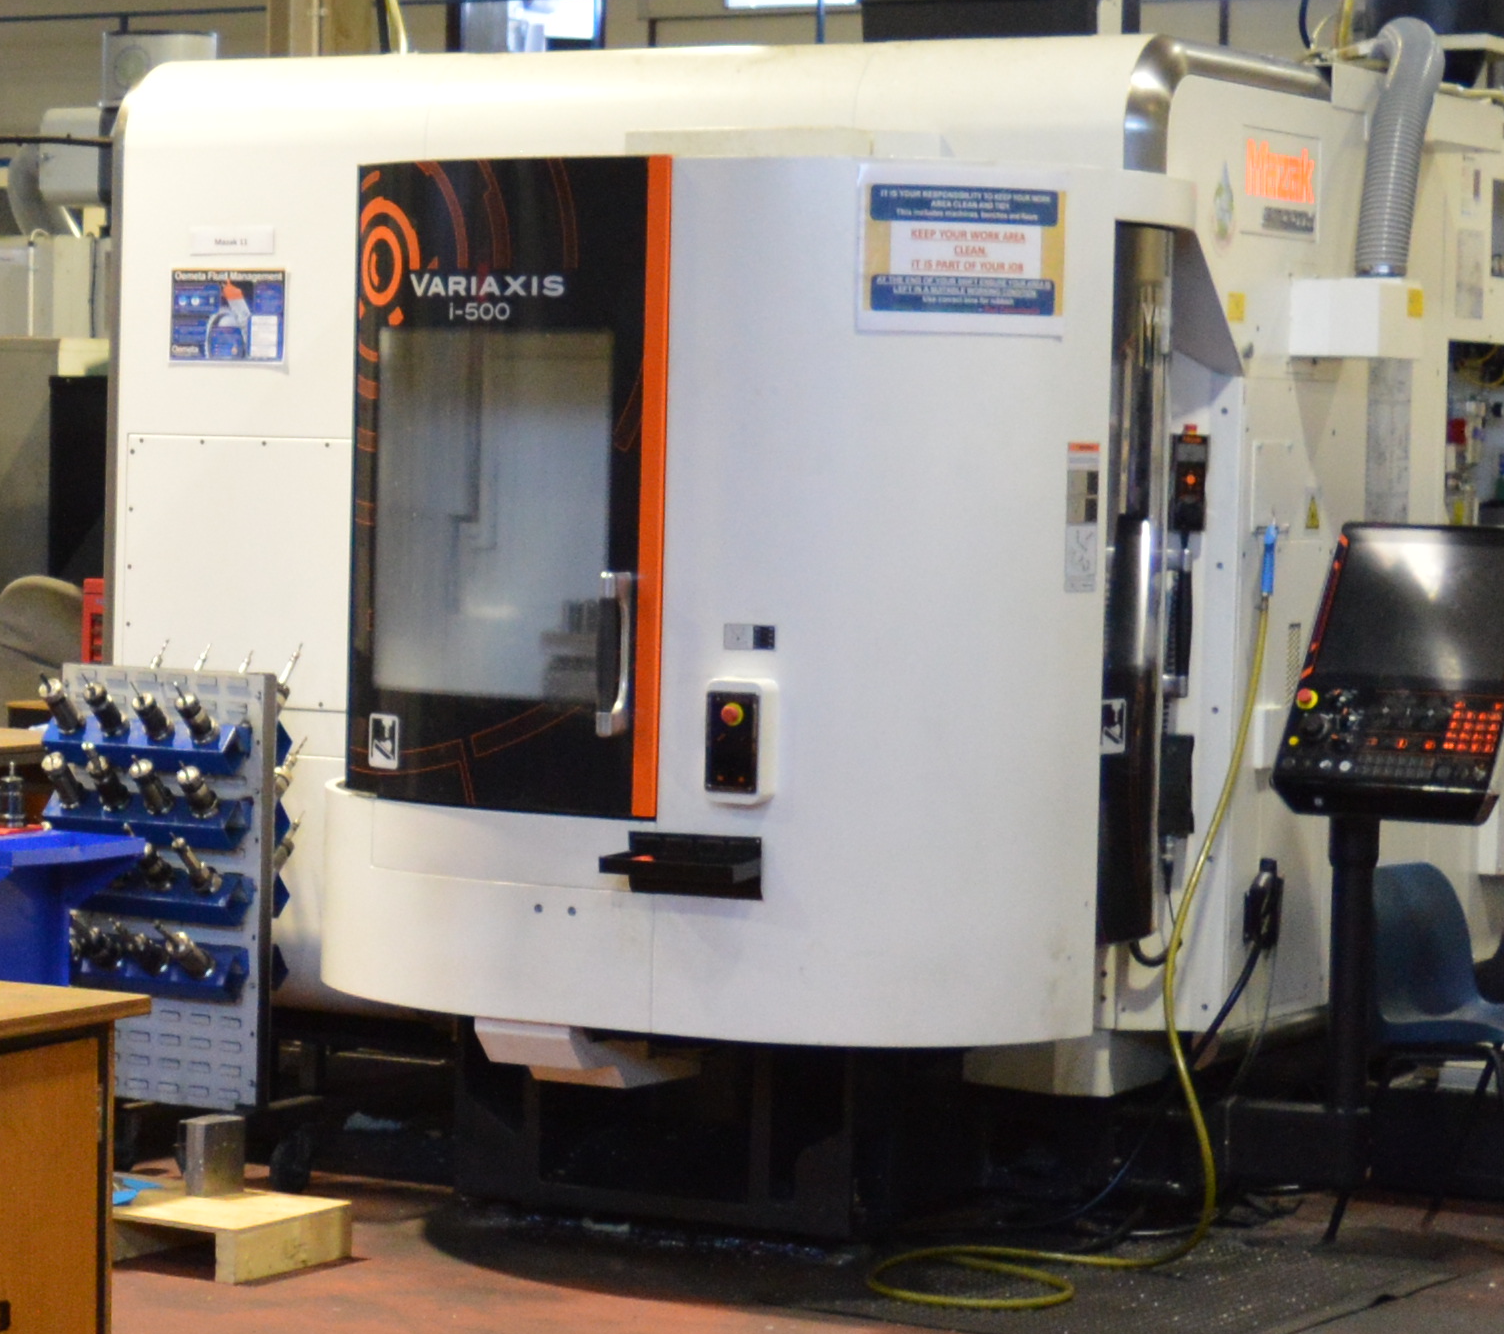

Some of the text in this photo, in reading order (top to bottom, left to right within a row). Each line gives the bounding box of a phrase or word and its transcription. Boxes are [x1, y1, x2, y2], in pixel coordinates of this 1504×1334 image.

[1245, 138, 1315, 204] Mazak
[911, 229, 1025, 242] KEEP YOUR WORK AREA
[911, 259, 1024, 273] IT IS PART OF YOUR JOB
[410, 273, 565, 297] VARIAXIS
[449, 302, 510, 320] i-500
